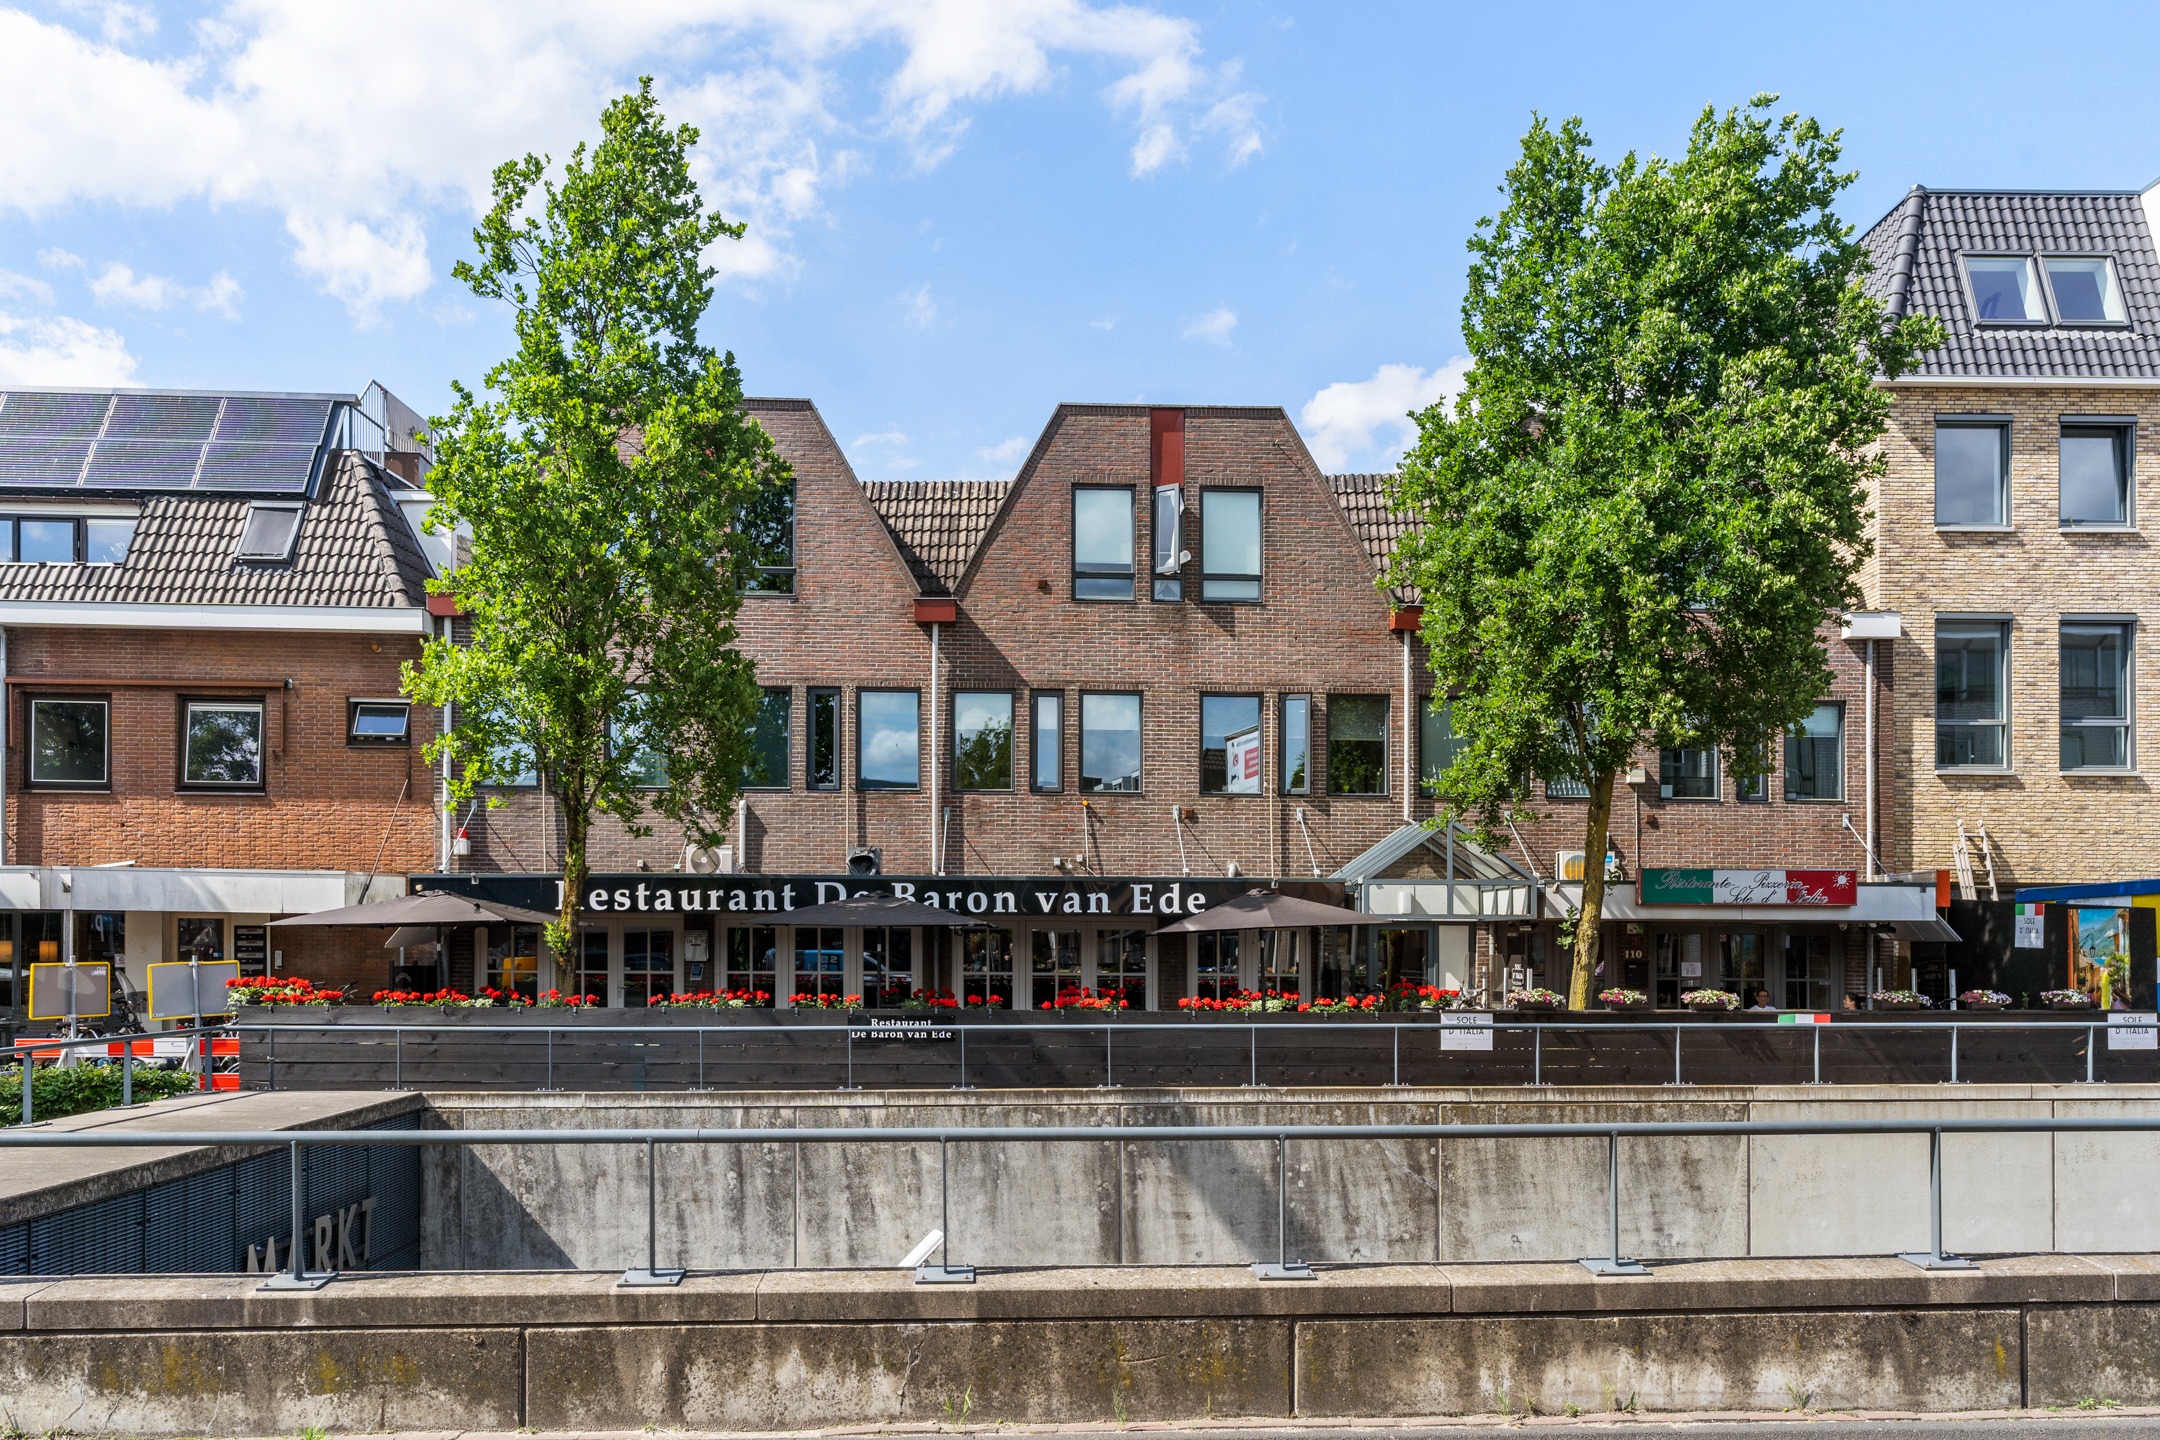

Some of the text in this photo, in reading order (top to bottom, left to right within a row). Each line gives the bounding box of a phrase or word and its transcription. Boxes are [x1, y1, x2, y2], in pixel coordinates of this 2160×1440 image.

[1749, 871, 1802, 889] Pizzeria
[555, 880, 1206, 914] estaurant D Baron van Ede
[2023, 917, 2035, 925] SOLE
[1624, 950, 1643, 959] 110
[870, 1018, 932, 1026] Restaurant
[1456, 1016, 1477, 1024] SOLE
[871, 1030, 903, 1038] Baron
